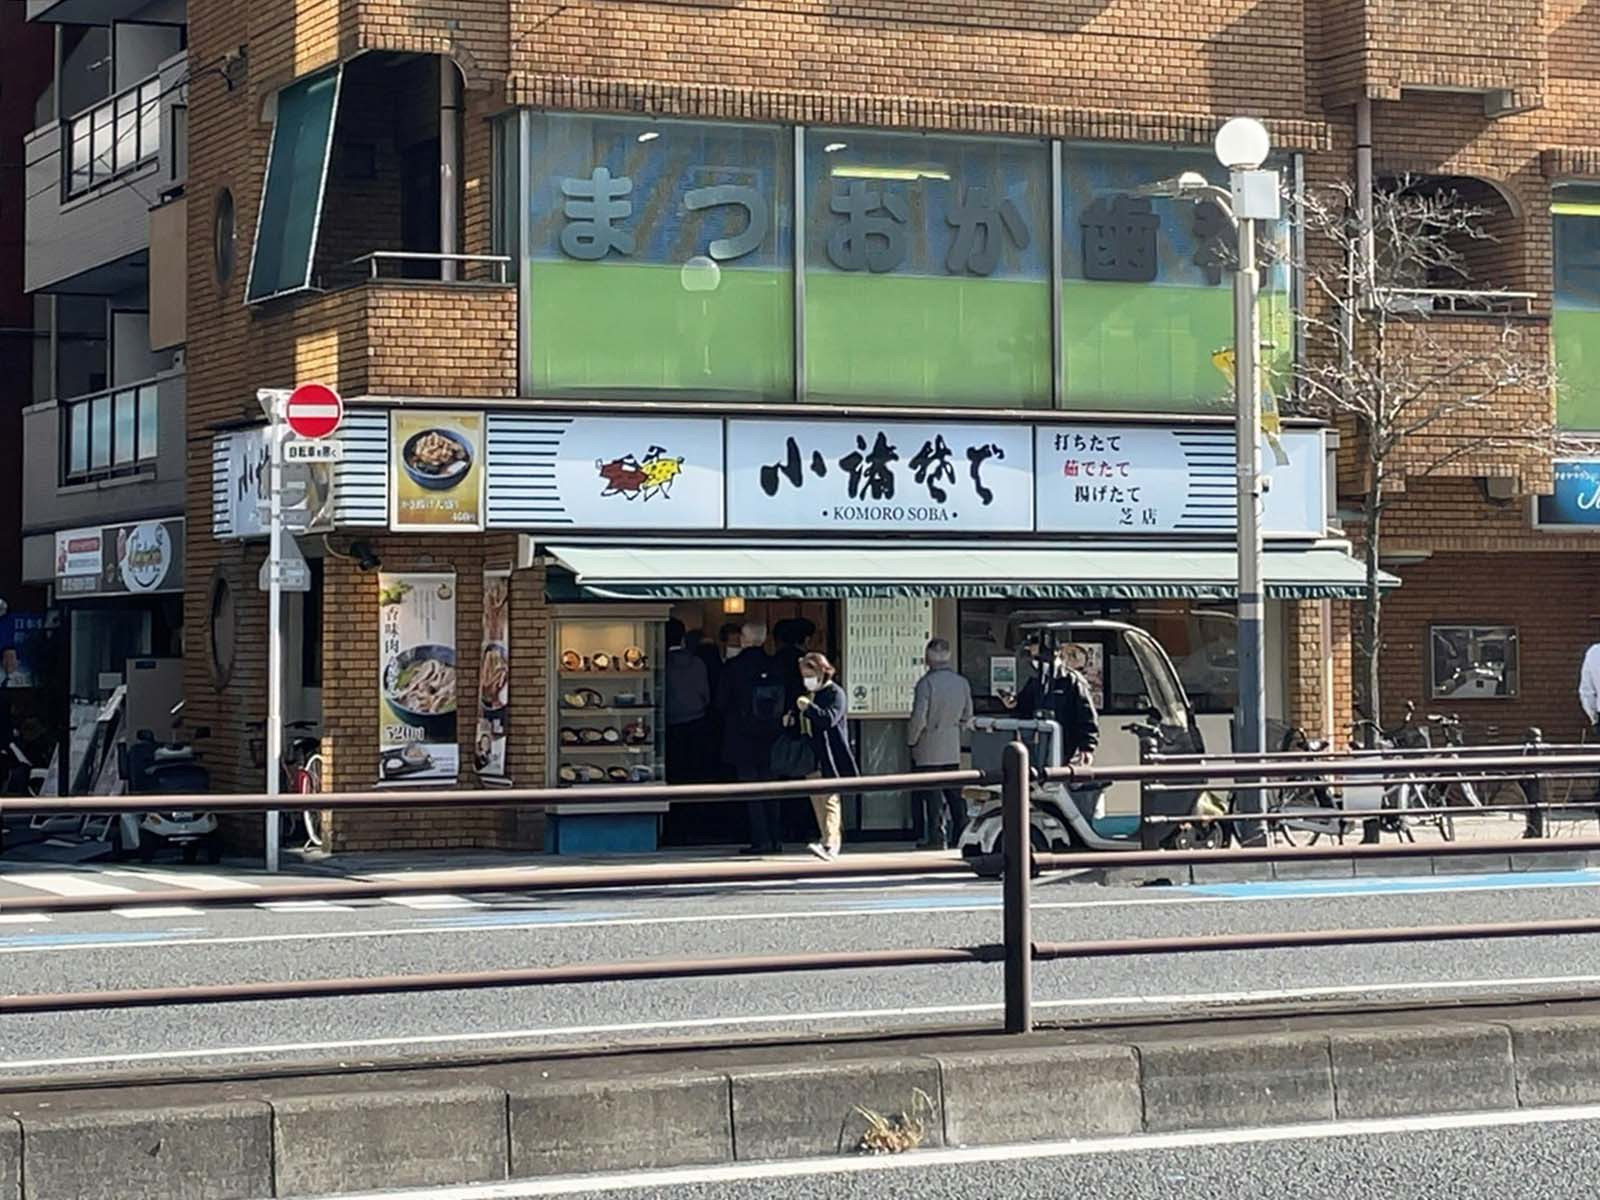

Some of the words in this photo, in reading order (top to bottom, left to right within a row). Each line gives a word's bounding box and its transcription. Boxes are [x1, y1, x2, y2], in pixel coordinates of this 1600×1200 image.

[1054, 433, 1121, 452] 打ちたて
[1063, 459, 1131, 478] 茹でたて
[1074, 485, 1141, 503] 揚げたて
[833, 506, 905, 521] KOMORO
[907, 507, 949, 522] SOBA
